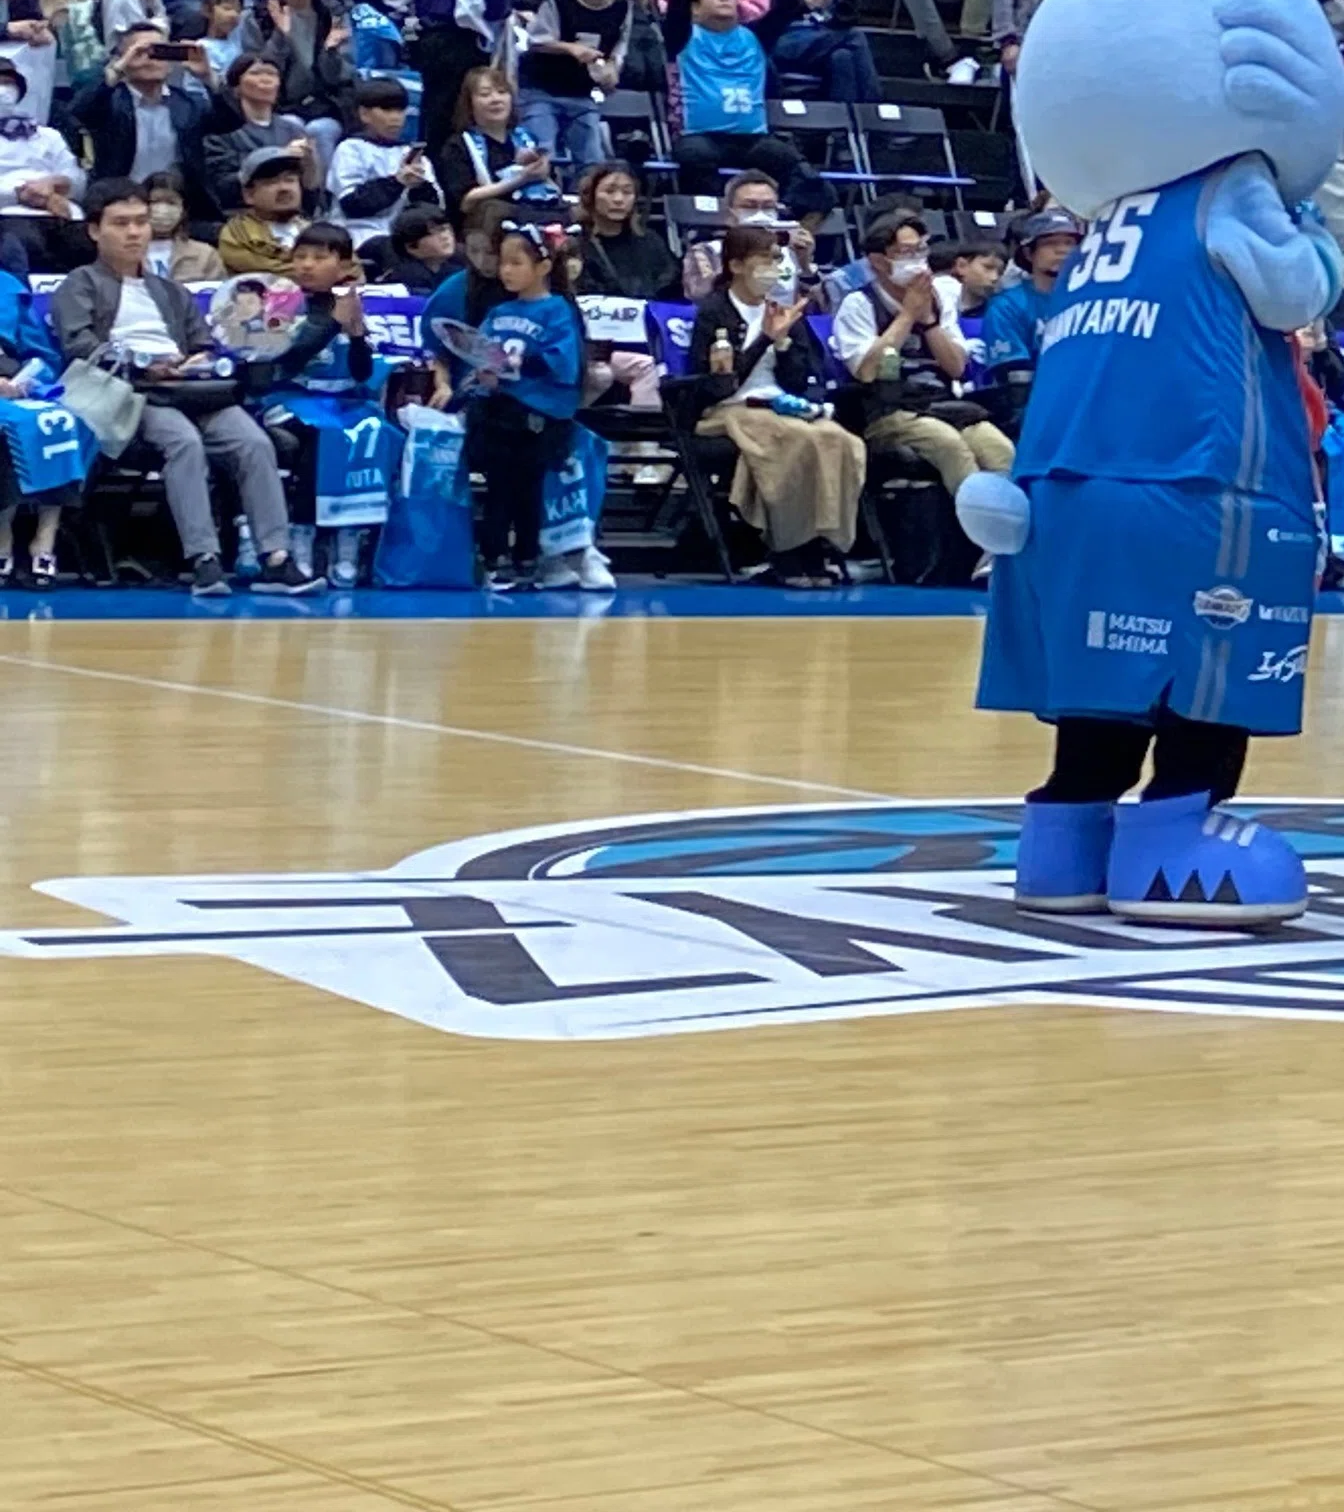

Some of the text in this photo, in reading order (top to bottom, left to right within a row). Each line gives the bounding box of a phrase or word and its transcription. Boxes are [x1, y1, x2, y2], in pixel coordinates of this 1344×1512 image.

[722, 88, 751, 113] 25
[37, 408, 80, 460] 13
[1109, 613, 1172, 636] MATSU
[1107, 633, 1168, 655] SHIMA
